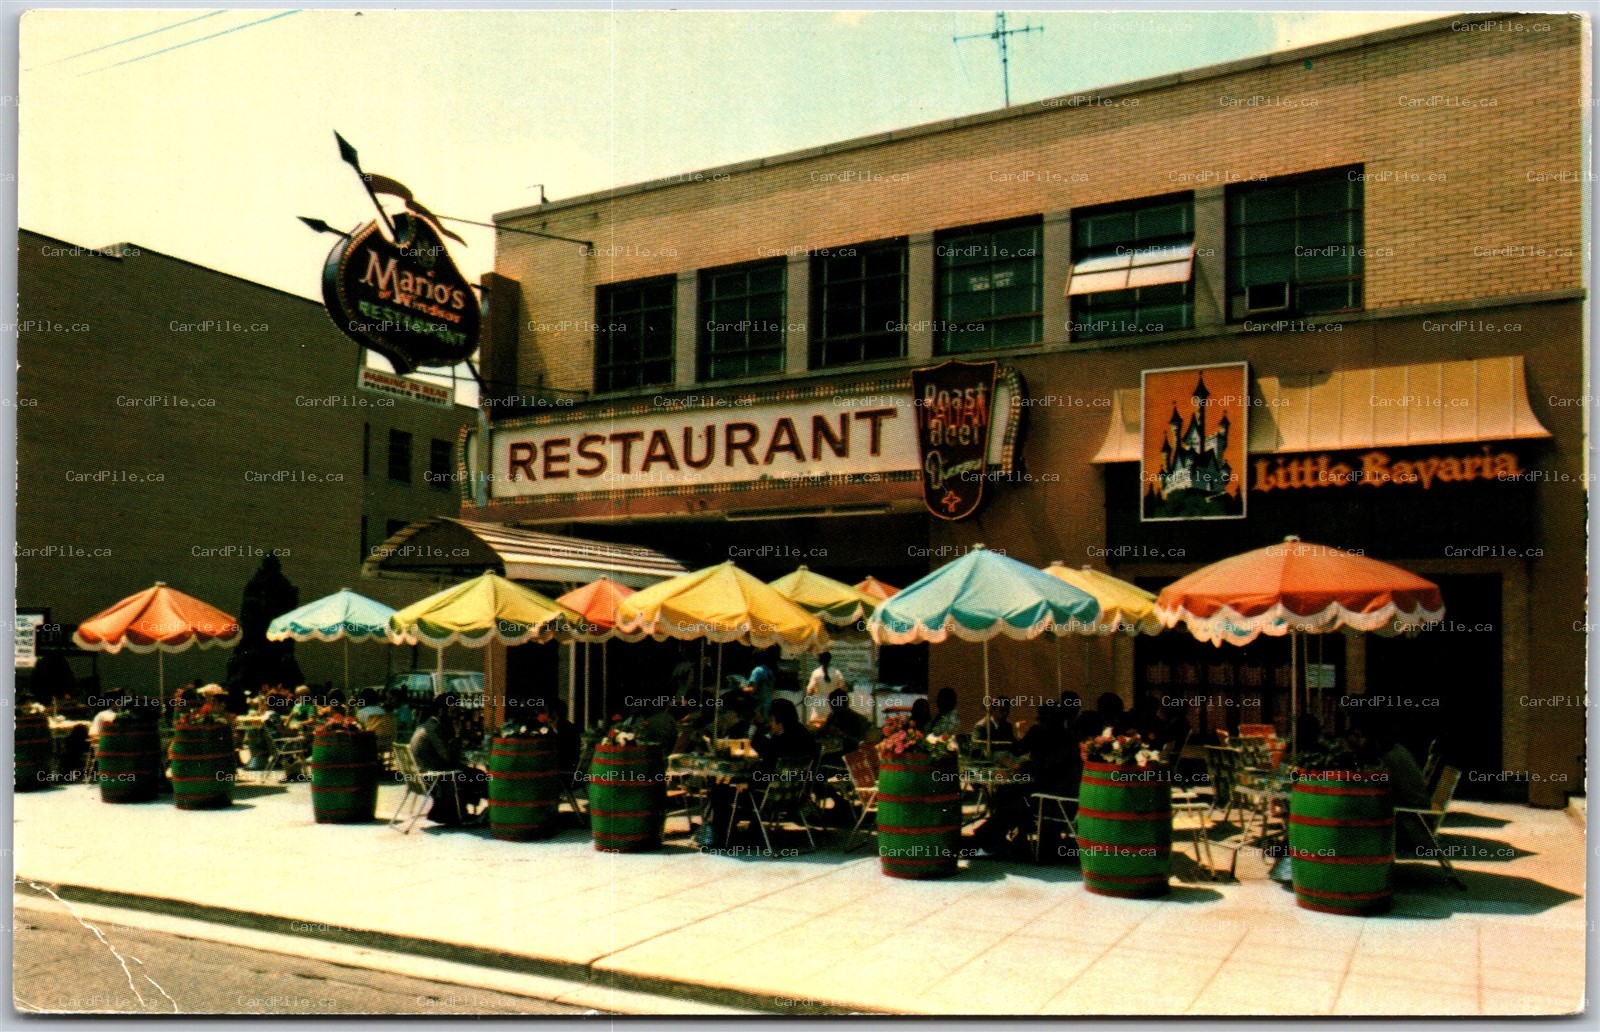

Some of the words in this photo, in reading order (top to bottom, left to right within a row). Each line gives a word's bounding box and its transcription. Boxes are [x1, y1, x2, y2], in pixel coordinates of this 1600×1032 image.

[359, 248, 466, 310] Mario's
[508, 407, 898, 482] RESTAURANT
[1252, 454, 1352, 492] Little
[1358, 446, 1525, 490] Bavaria
